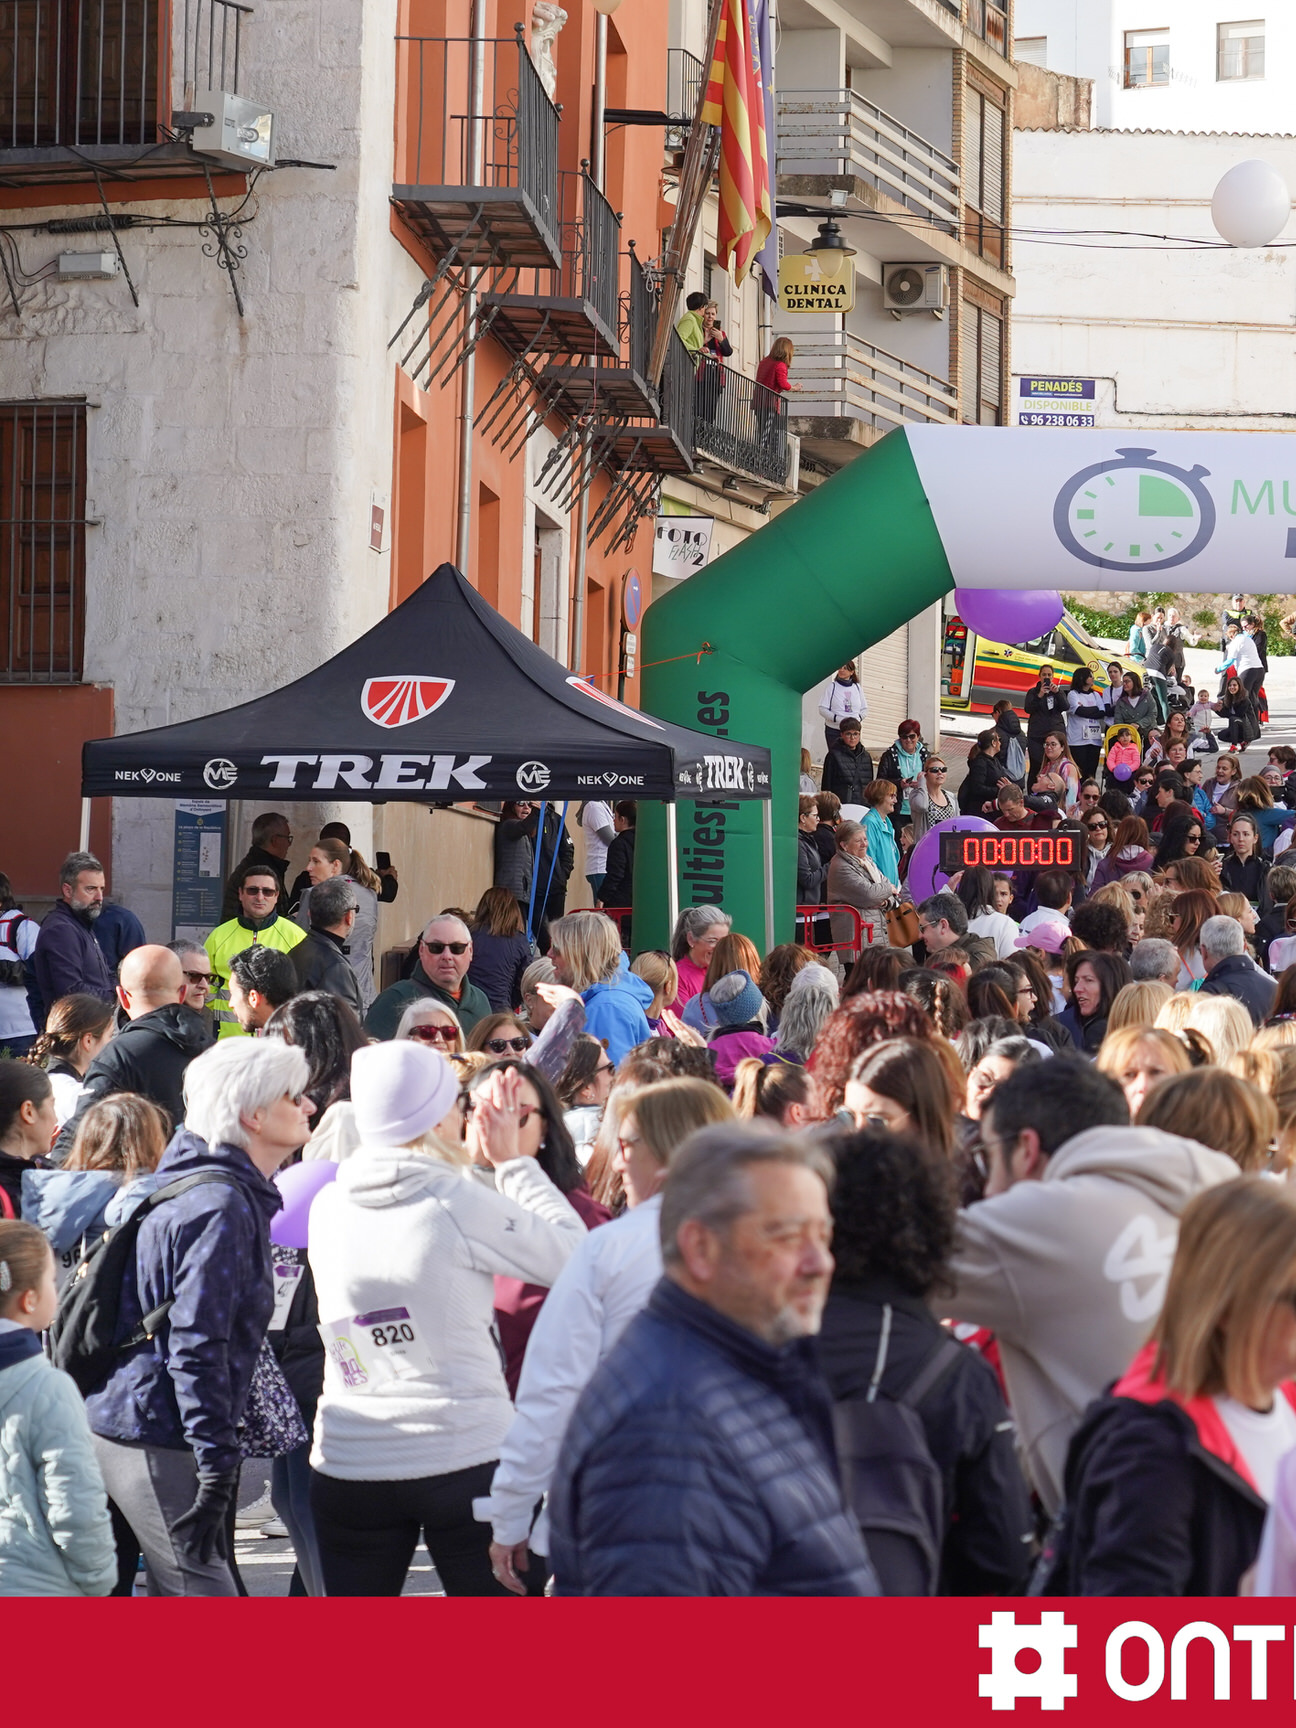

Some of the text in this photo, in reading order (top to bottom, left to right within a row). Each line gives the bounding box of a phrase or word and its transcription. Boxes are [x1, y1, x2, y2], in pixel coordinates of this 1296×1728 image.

[784, 284, 847, 295] CLINICA
[786, 298, 843, 309] DENTAL
[1030, 380, 1083, 392] PENADÉS
[1024, 400, 1092, 412] DISPONIBLE
[1031, 414, 1093, 427] 96 238 06 33
[657, 526, 708, 546] FOTO
[668, 543, 702, 563] FLASH
[692, 552, 704, 567] 2
[260, 755, 493, 789] TREK
[703, 755, 745, 789] TREK
[963, 837, 1073, 866] 00:00:00
[371, 1323, 415, 1347] 820
